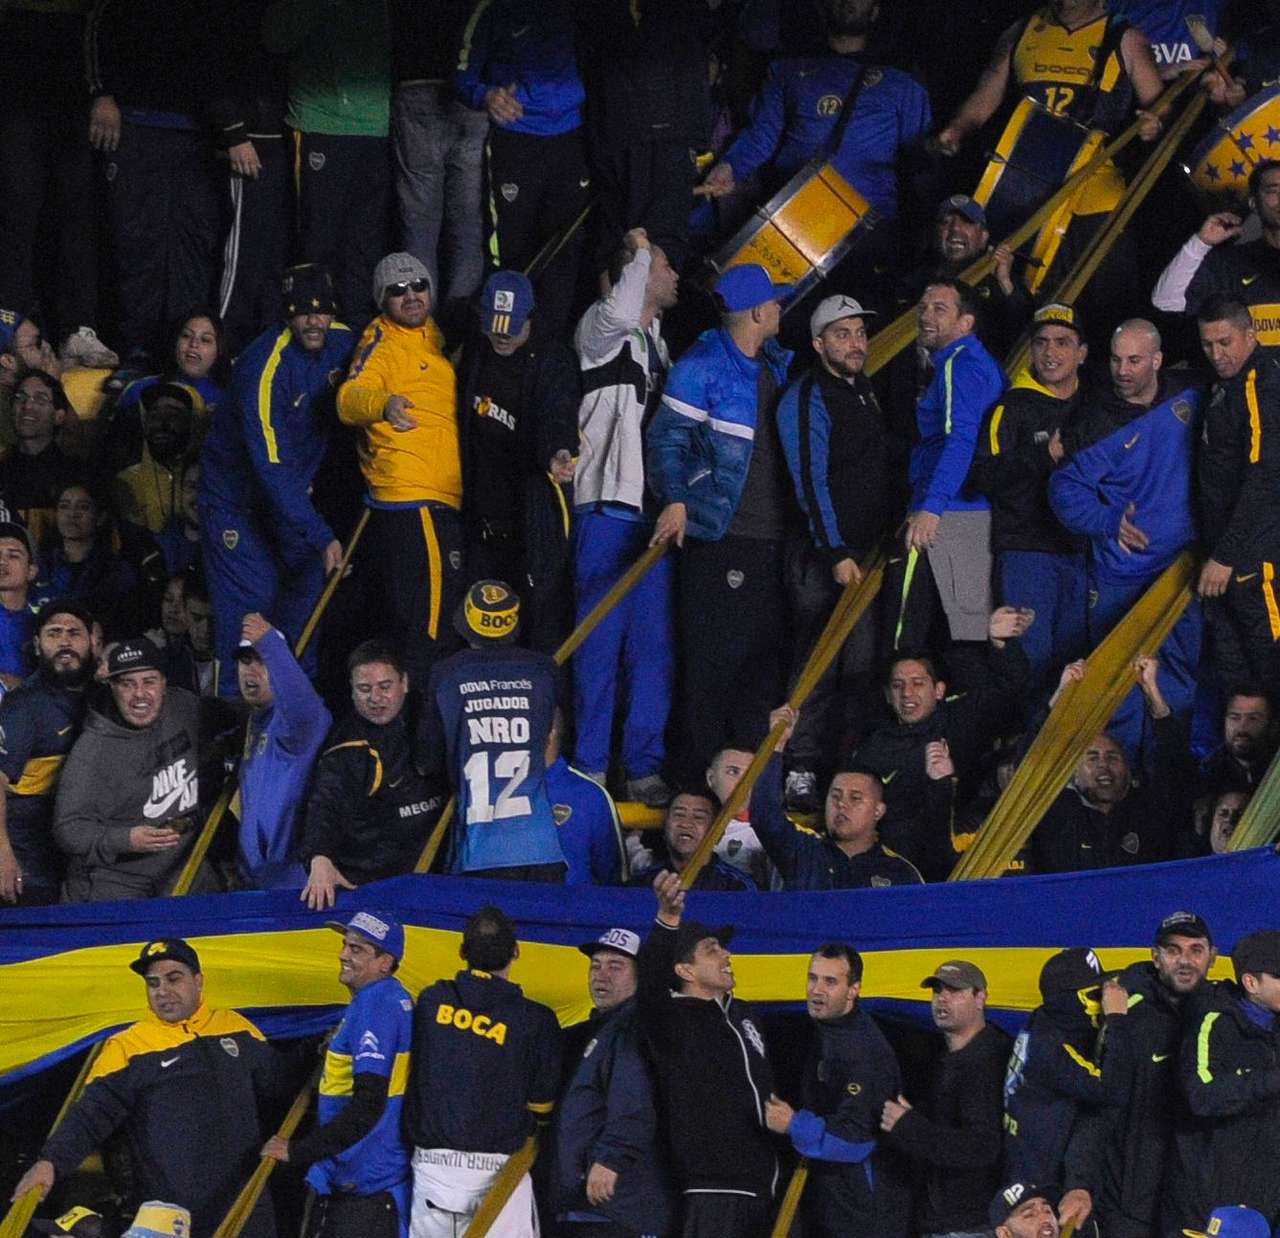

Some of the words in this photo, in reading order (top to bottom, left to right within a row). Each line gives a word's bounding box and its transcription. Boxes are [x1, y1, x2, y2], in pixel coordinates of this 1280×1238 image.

[1046, 87, 1074, 117] 12
[461, 682, 489, 695] BBVA
[463, 696, 529, 712] JUGADOR
[470, 716, 530, 744] NRO
[154, 759, 190, 801] NIKE
[462, 750, 531, 825] 12
[437, 1003, 508, 1046] BOCA
